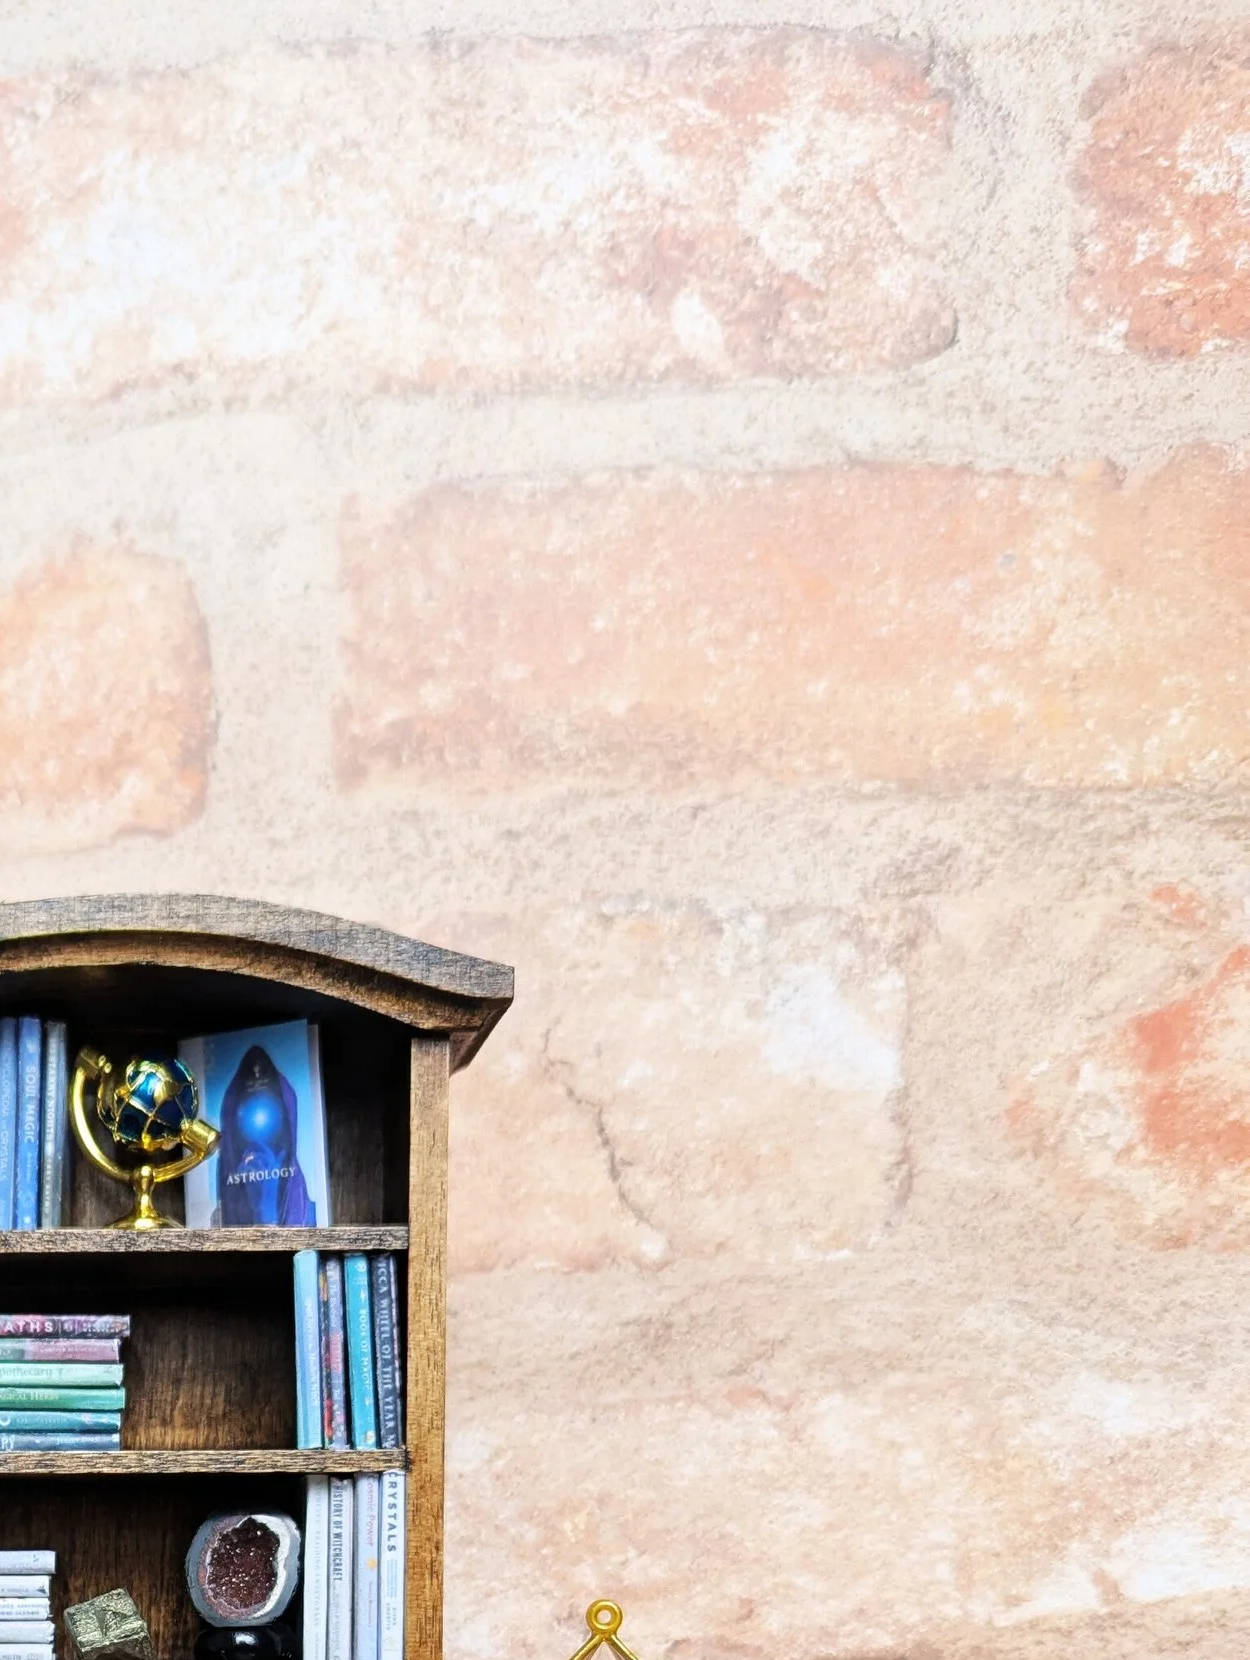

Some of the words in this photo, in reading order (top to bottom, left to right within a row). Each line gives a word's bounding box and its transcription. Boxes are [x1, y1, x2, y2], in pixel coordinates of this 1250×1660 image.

[25, 1065, 35, 1098] SOUL
[24, 1105, 35, 1143] MAGIC
[226, 1167, 295, 1185] ASTROLOGY
[377, 1259, 388, 1293] ICCA
[359, 1308, 367, 1336] BOOK
[379, 1300, 389, 1339] WHEEL
[360, 1341, 369, 1352] OF
[381, 1345, 391, 1359] OF
[381, 1366, 392, 1389] THE
[384, 1397, 394, 1429] YEAR
[333, 1486, 343, 1517] HISTORY
[366, 1475, 375, 1512] Cosmic
[333, 1521, 343, 1529] OF
[387, 1472, 398, 1552] CRYSTALS
[365, 1515, 375, 1547] Power
[333, 1533, 342, 1581] WITCHCRAFT
